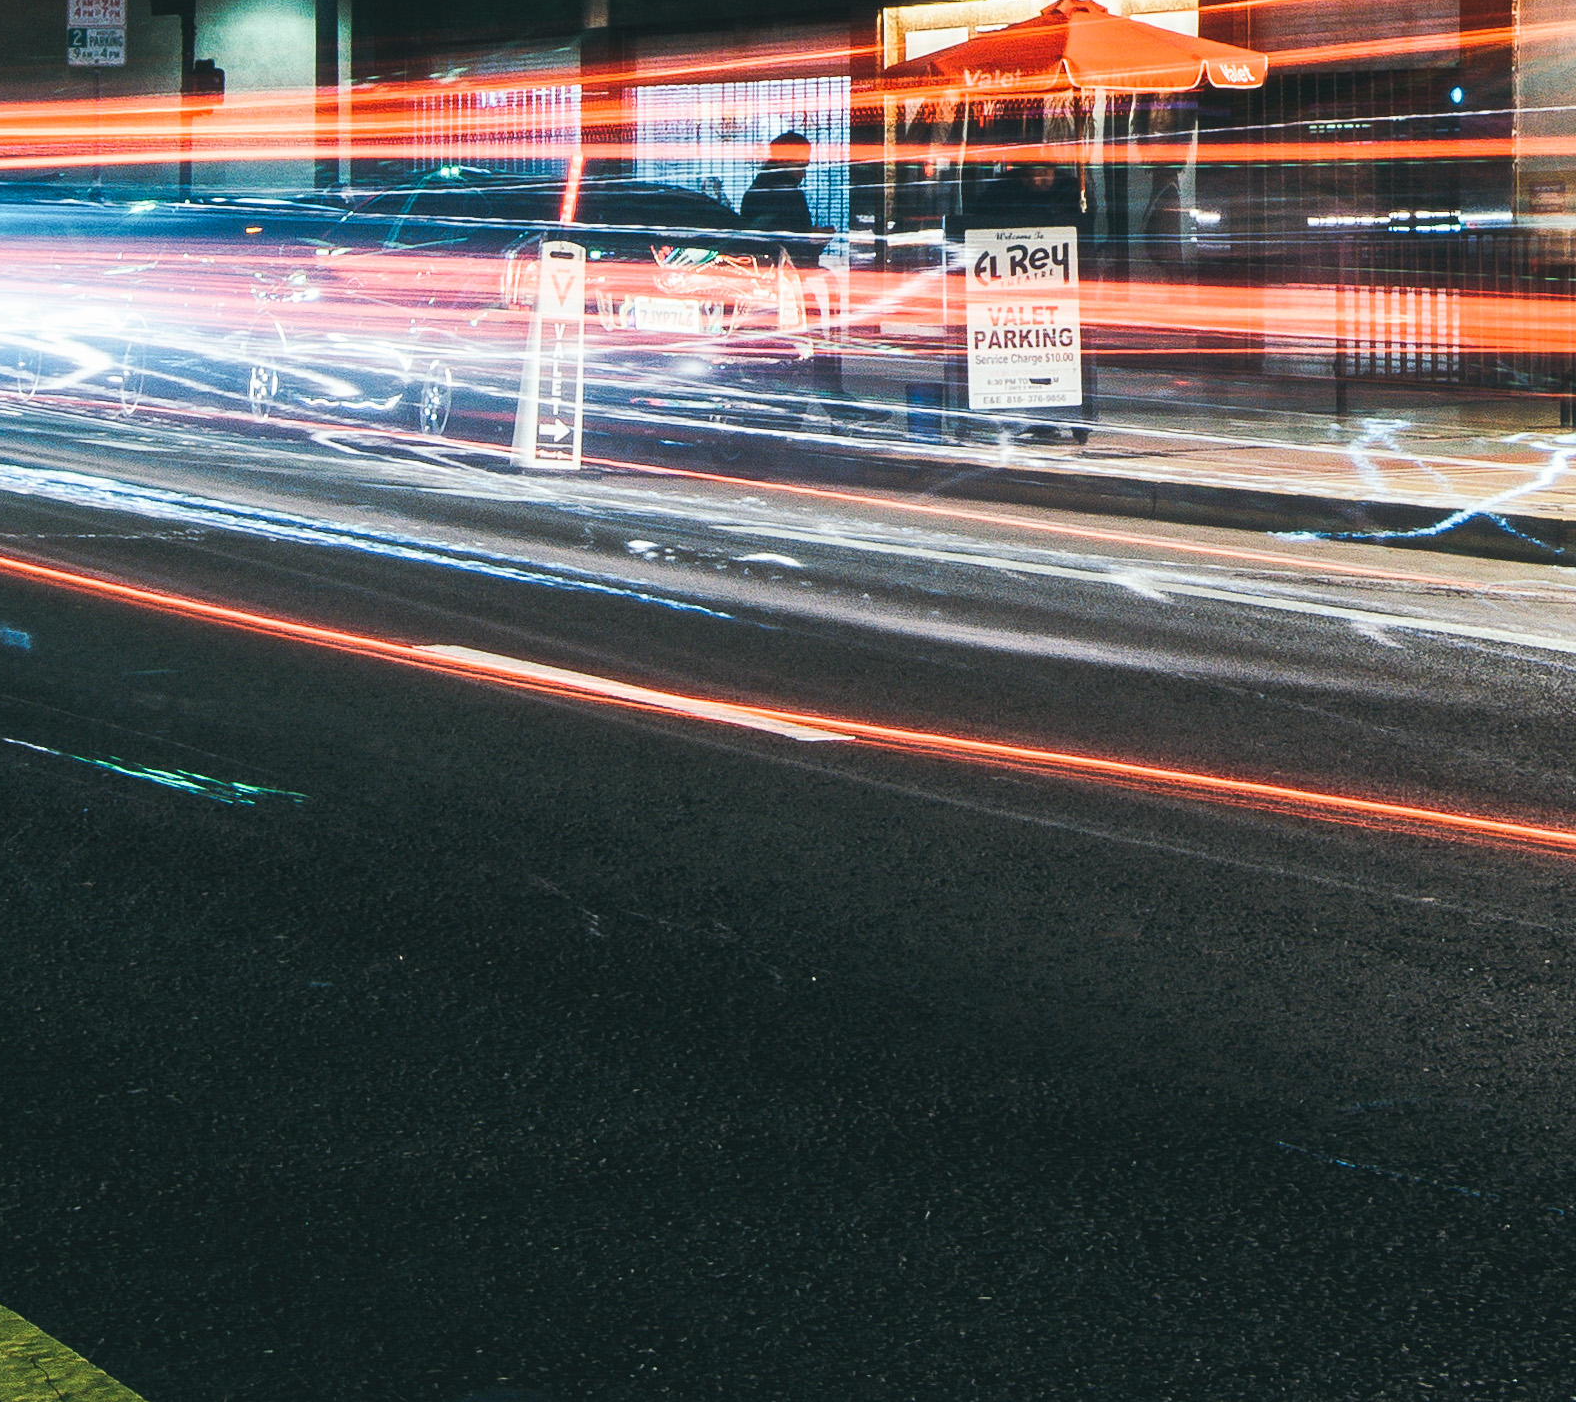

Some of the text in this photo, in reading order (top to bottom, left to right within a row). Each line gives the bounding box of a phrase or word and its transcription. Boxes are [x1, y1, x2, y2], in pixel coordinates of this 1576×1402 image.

[73, 29, 83, 46] 2
[964, 68, 1023, 88] Valet
[1219, 62, 1256, 84] Valet
[1000, 268, 1054, 288] THEATRE
[987, 305, 1059, 327] VALET
[974, 327, 1073, 350] PARKING
[550, 322, 566, 416] VALET
[975, 352, 1074, 366] Service Charge $10.00
